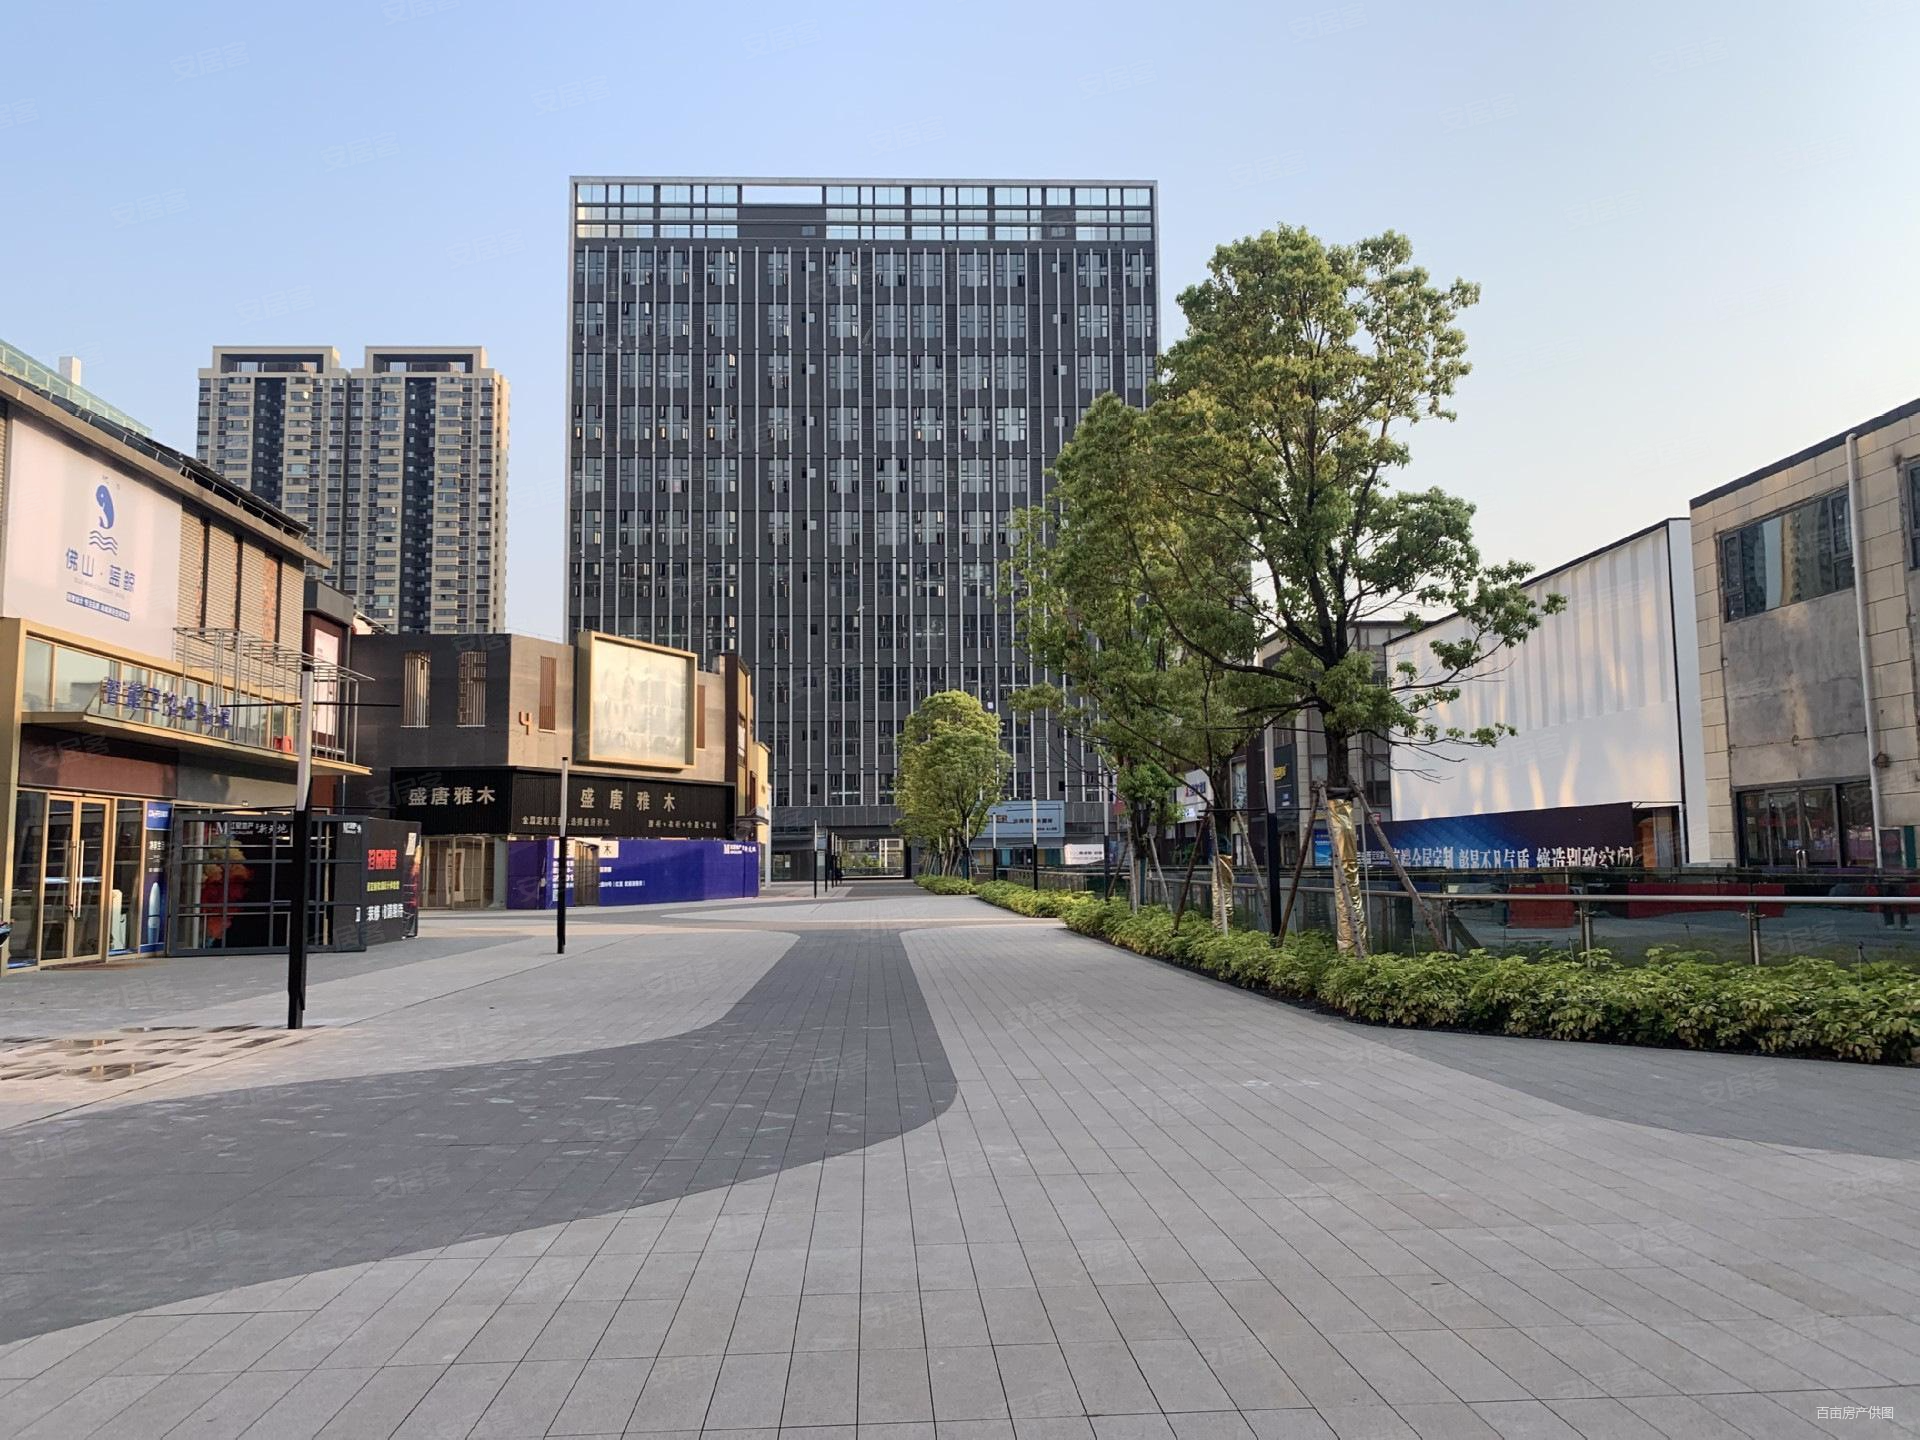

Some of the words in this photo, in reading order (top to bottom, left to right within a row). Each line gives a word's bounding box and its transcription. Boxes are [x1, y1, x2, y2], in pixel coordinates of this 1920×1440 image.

[407, 785, 496, 806] 盛唐雅木
[580, 786, 676, 812] 盛唐雅木
